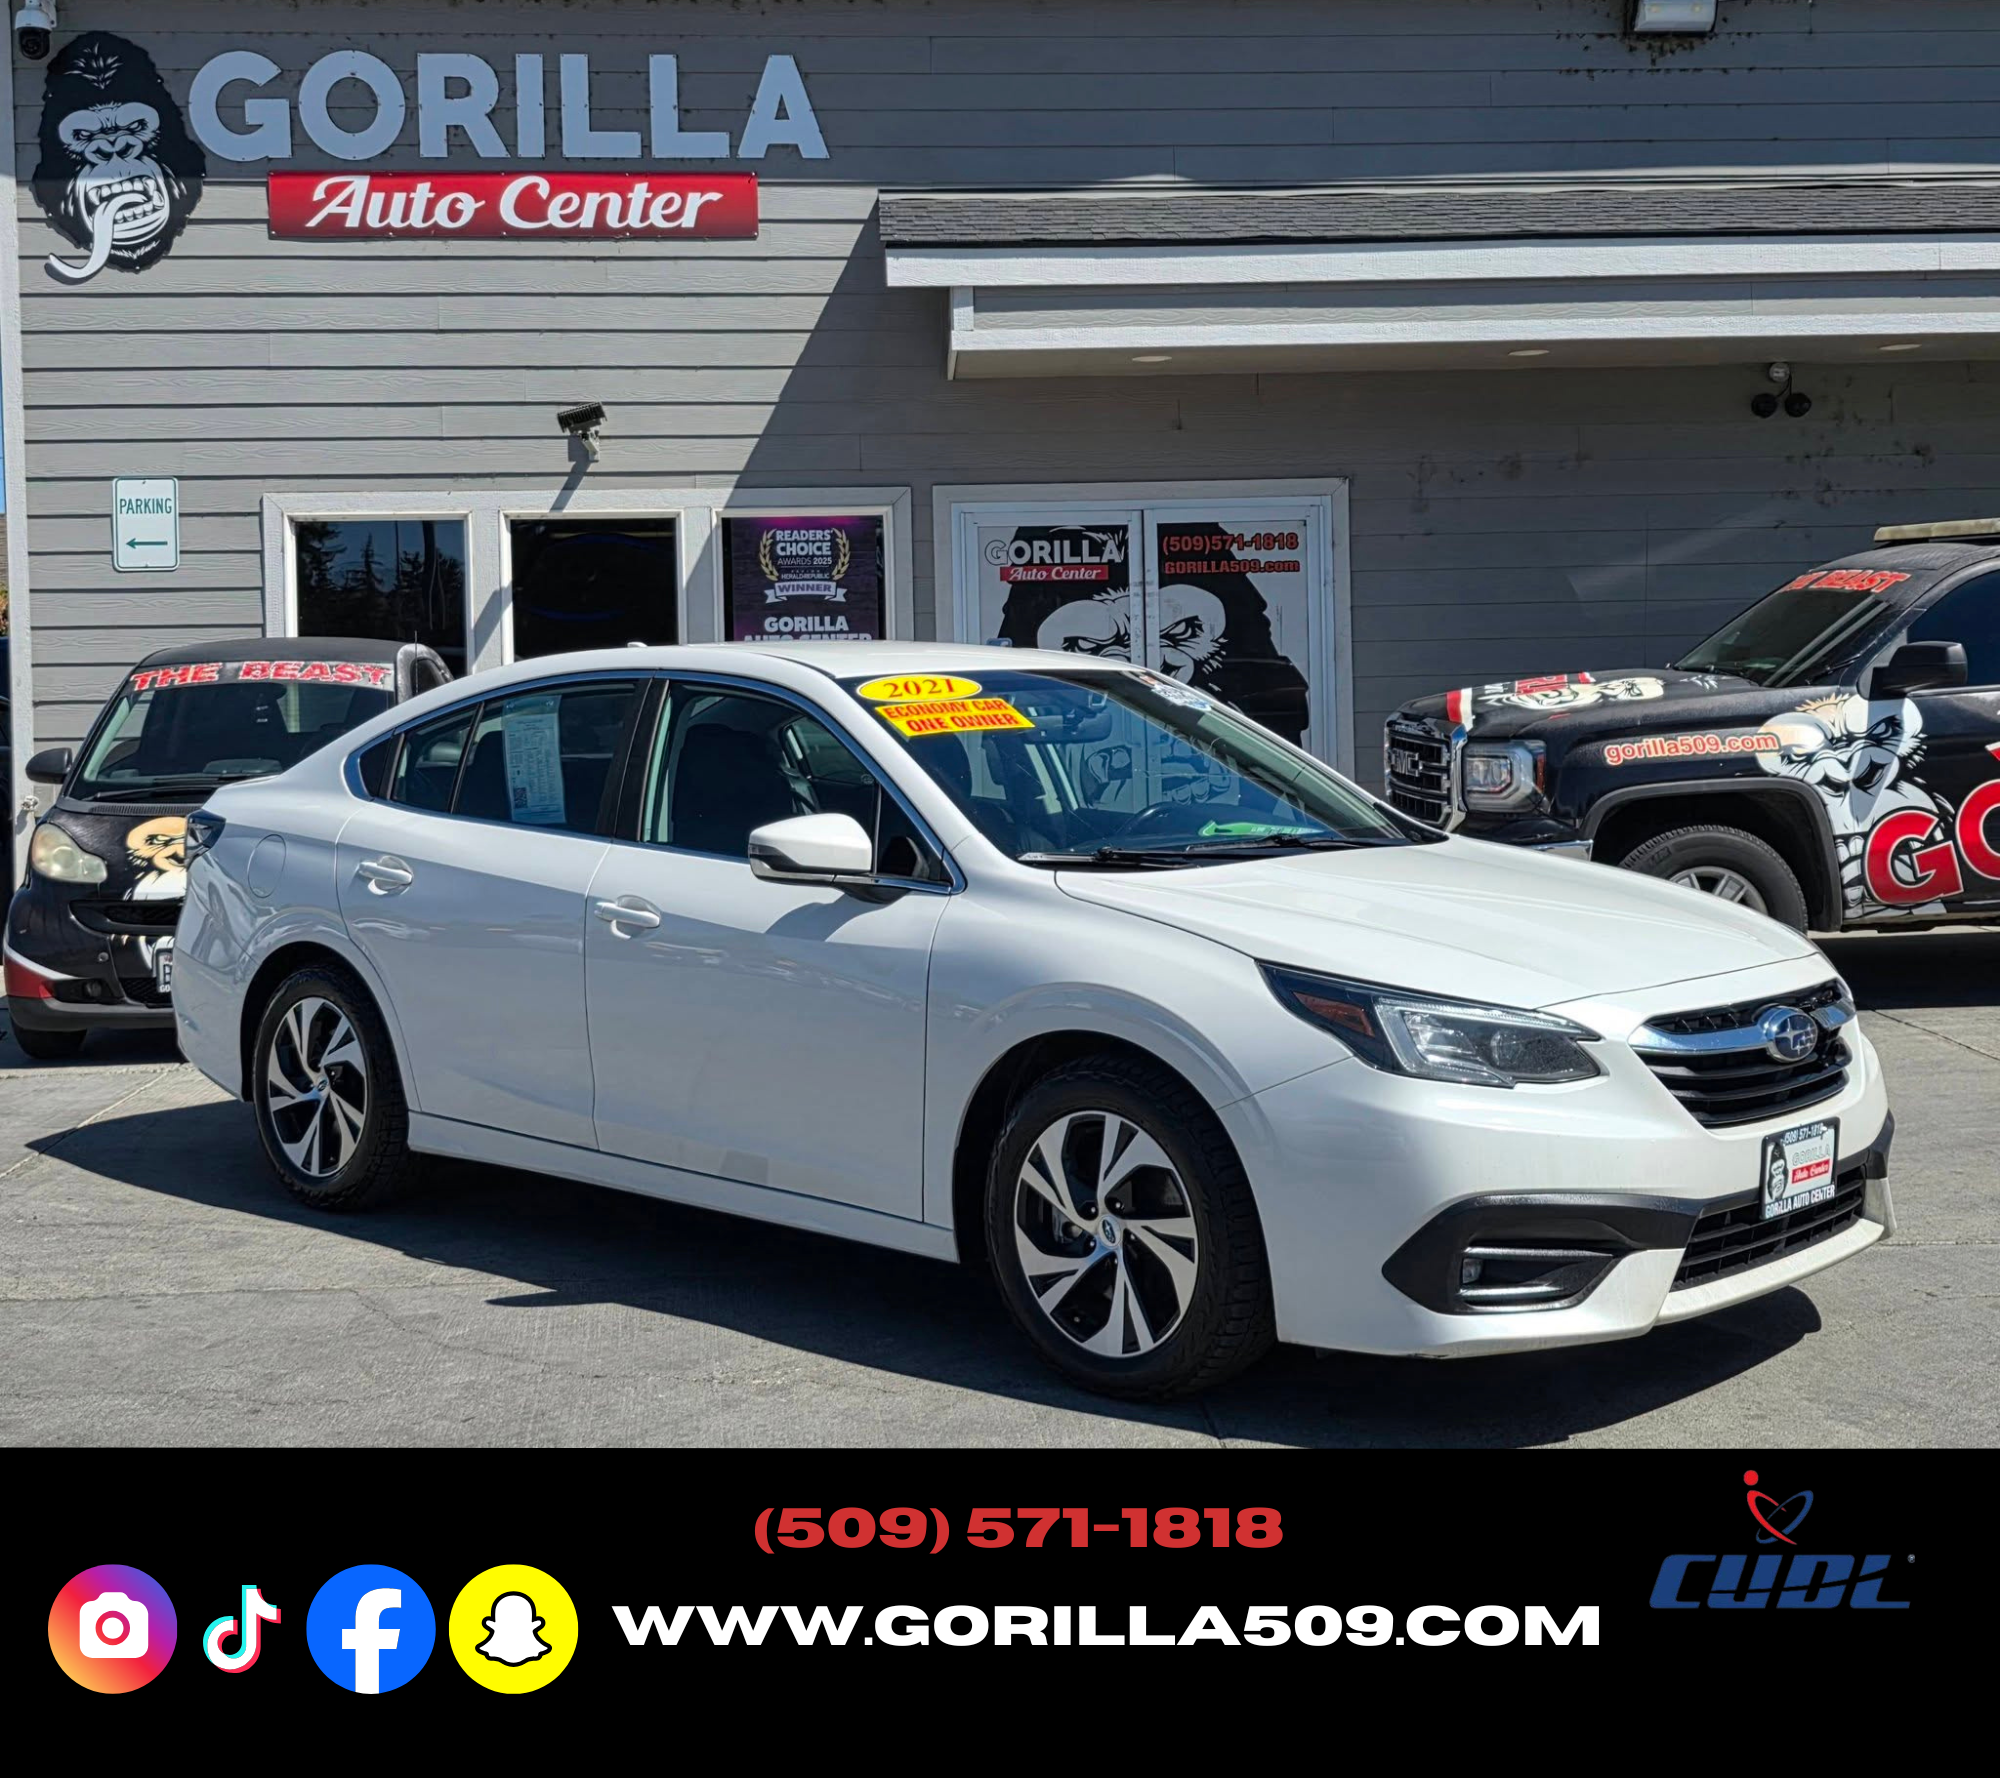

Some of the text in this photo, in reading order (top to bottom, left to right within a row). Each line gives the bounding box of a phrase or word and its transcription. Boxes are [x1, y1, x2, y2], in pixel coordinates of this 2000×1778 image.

[189, 50, 830, 162] GORILLA
[306, 175, 722, 230] Auto Center
[119, 498, 172, 514] PARKING
[776, 529, 833, 541] READERS'
[1162, 532, 1299, 555] (509)571-1818
[776, 542, 831, 556] CHOICE
[984, 539, 1122, 566] GORILLA
[777, 556, 833, 565] AWARDS 2025
[1165, 559, 1300, 574] GORILLA509.com
[1009, 566, 1102, 580] Auto Center
[778, 583, 832, 593] WINNER
[764, 615, 849, 632] GORILLA
[130, 661, 392, 691] THE BEAST
[884, 678, 955, 698] 2021
[882, 698, 1009, 719] ECONOMY CAR
[906, 714, 1020, 732] ONE OWNER
[1605, 734, 1778, 765] gorilla509.com
[1792, 1144, 1831, 1167] GORILLA
[1765, 1183, 1835, 1218] GORILLA AUTO CENTER
